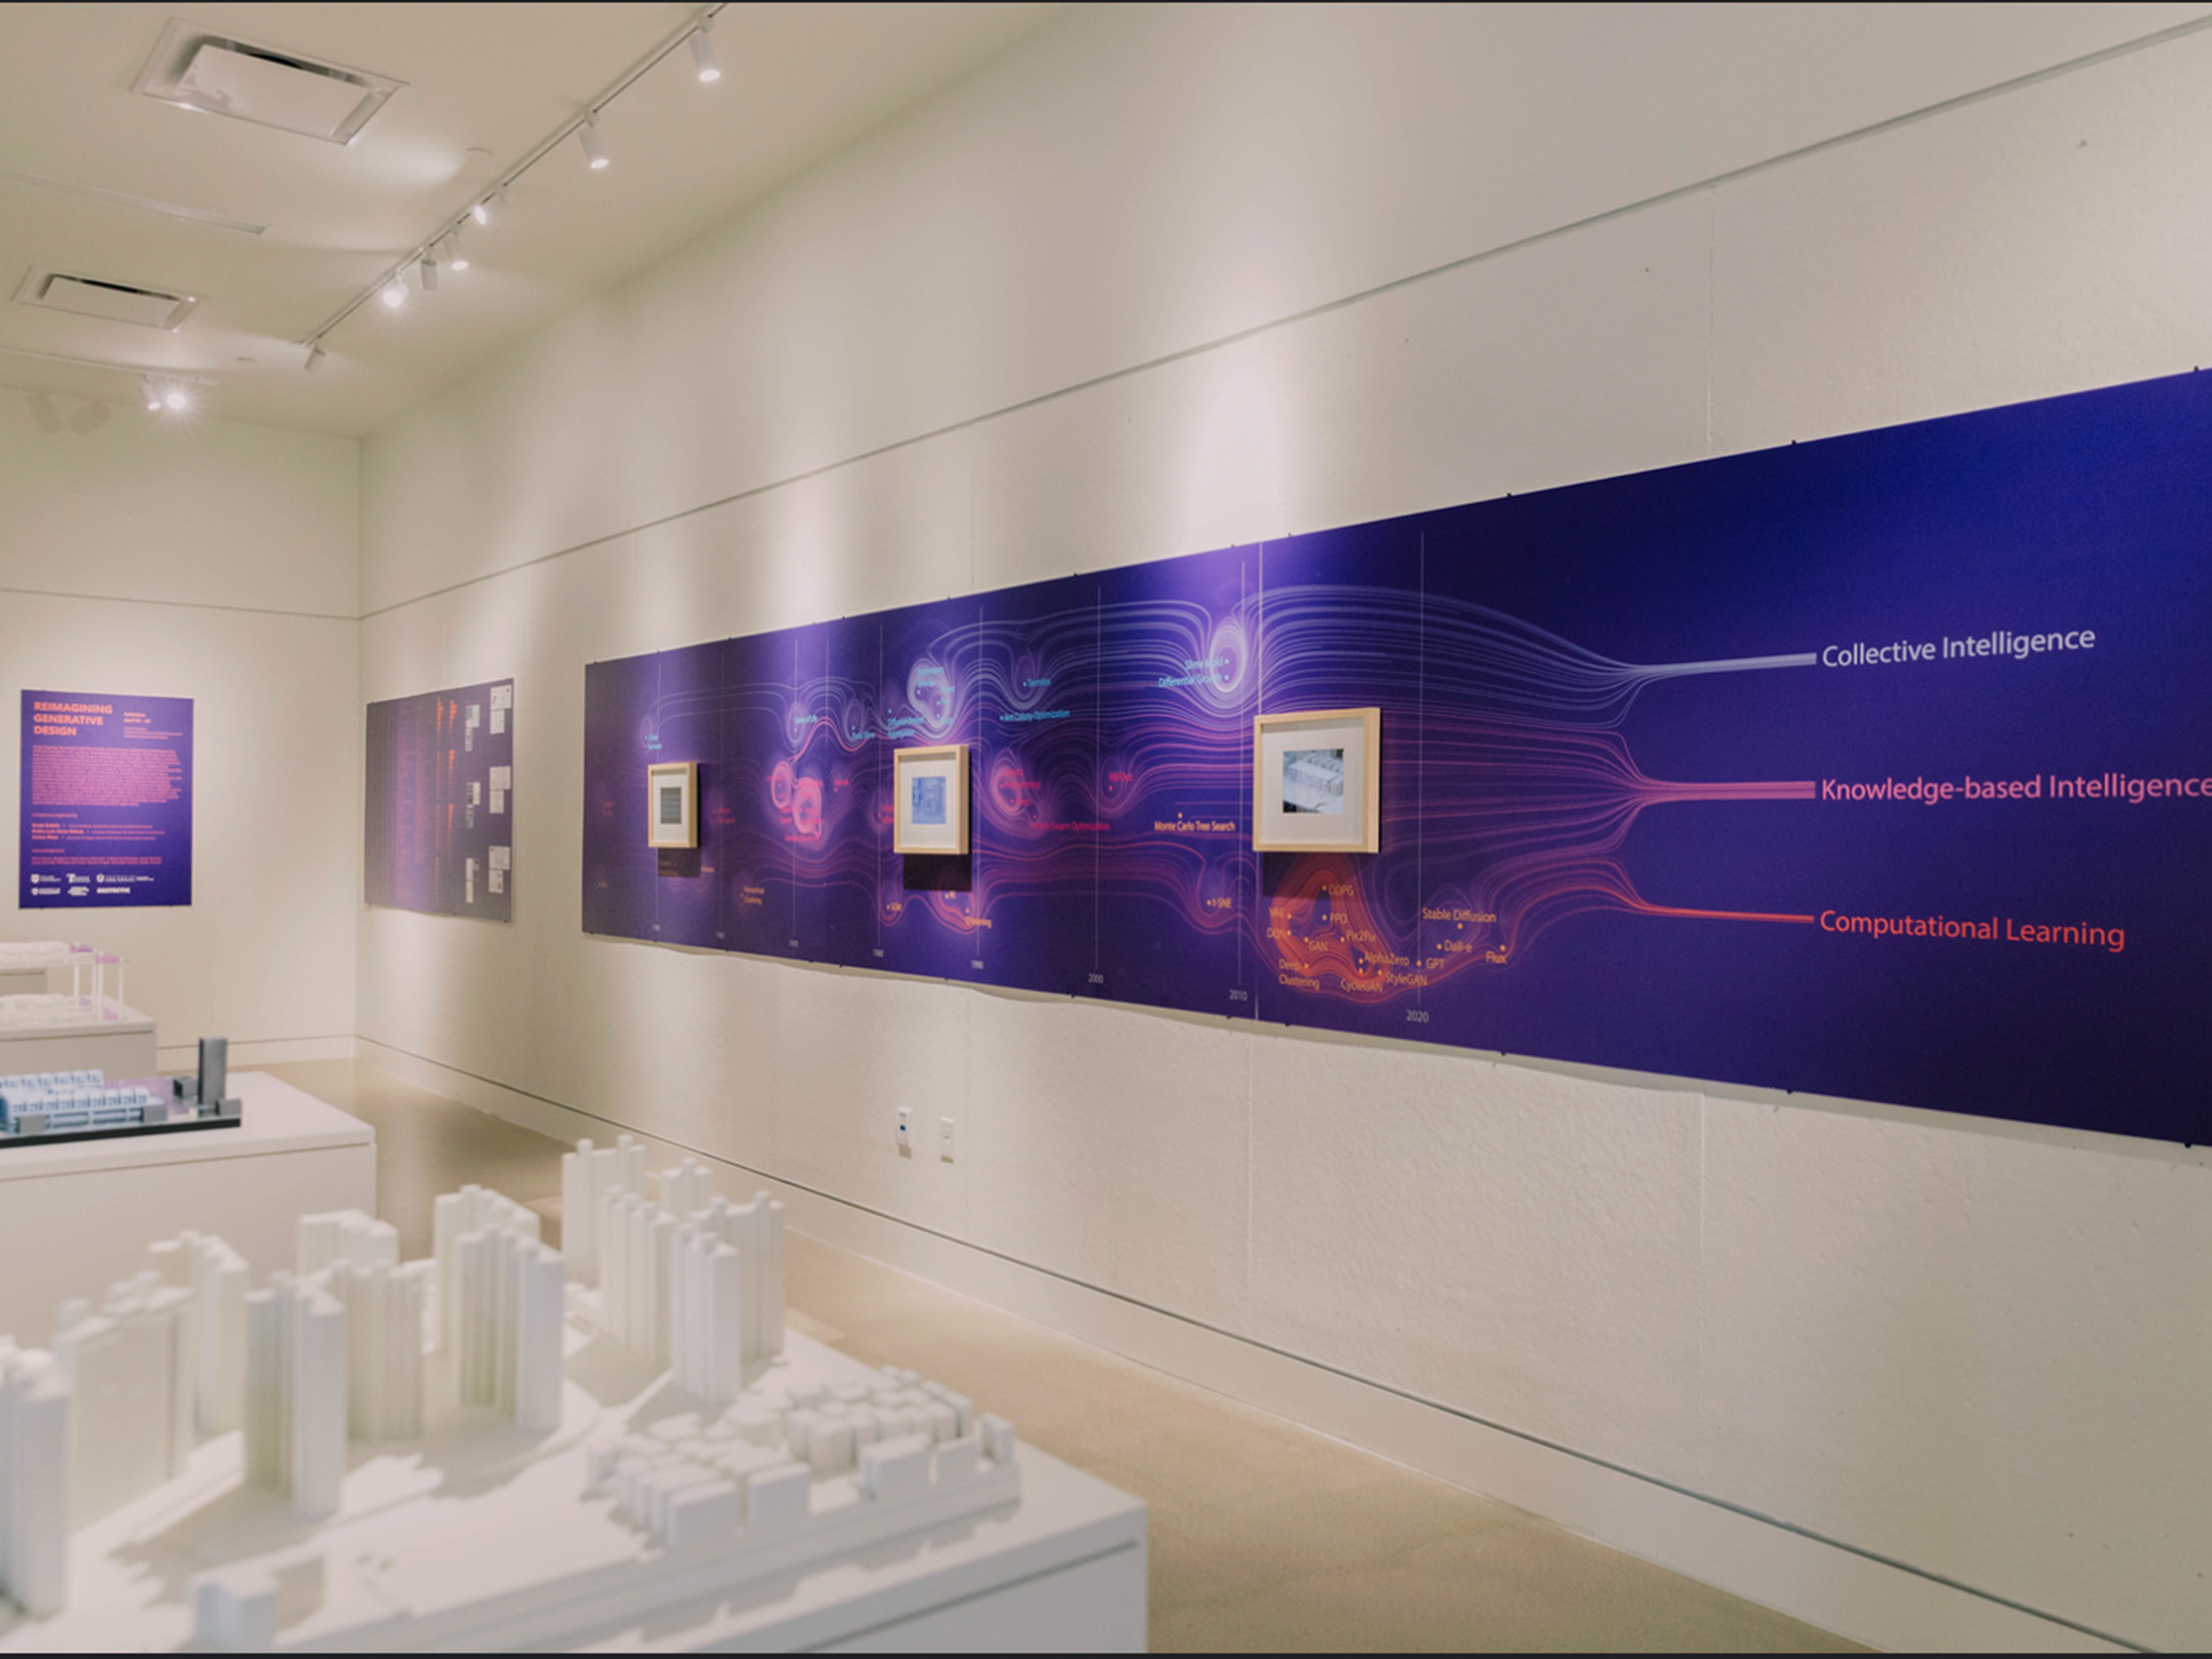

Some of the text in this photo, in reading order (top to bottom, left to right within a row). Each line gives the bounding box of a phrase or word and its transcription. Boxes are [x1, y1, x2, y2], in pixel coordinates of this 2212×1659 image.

[1823, 629, 2096, 667] Collective Intelligence
[33, 702, 113, 714] REIMAGINING
[33, 714, 104, 726] GENERATIVE
[33, 725, 77, 736] DESIGN
[1822, 773, 2212, 805] Knowledge-based Intelligence
[1154, 820, 1236, 832] Monte Carlo Tree Search
[1330, 913, 1347, 925] PPO
[1422, 907, 1497, 923] Stable Diffusion
[1820, 910, 2125, 953] Computational Learning
[1309, 940, 1328, 952] GAN
[1364, 951, 1410, 967] AlphaZero
[1426, 958, 1445, 969] GPT
[1486, 951, 1507, 964] Flux
[1088, 973, 1104, 983] 2000
[1278, 974, 1320, 990] Clustering
[1230, 989, 1247, 1001] 2010
[1406, 1010, 1429, 1023] 2020
